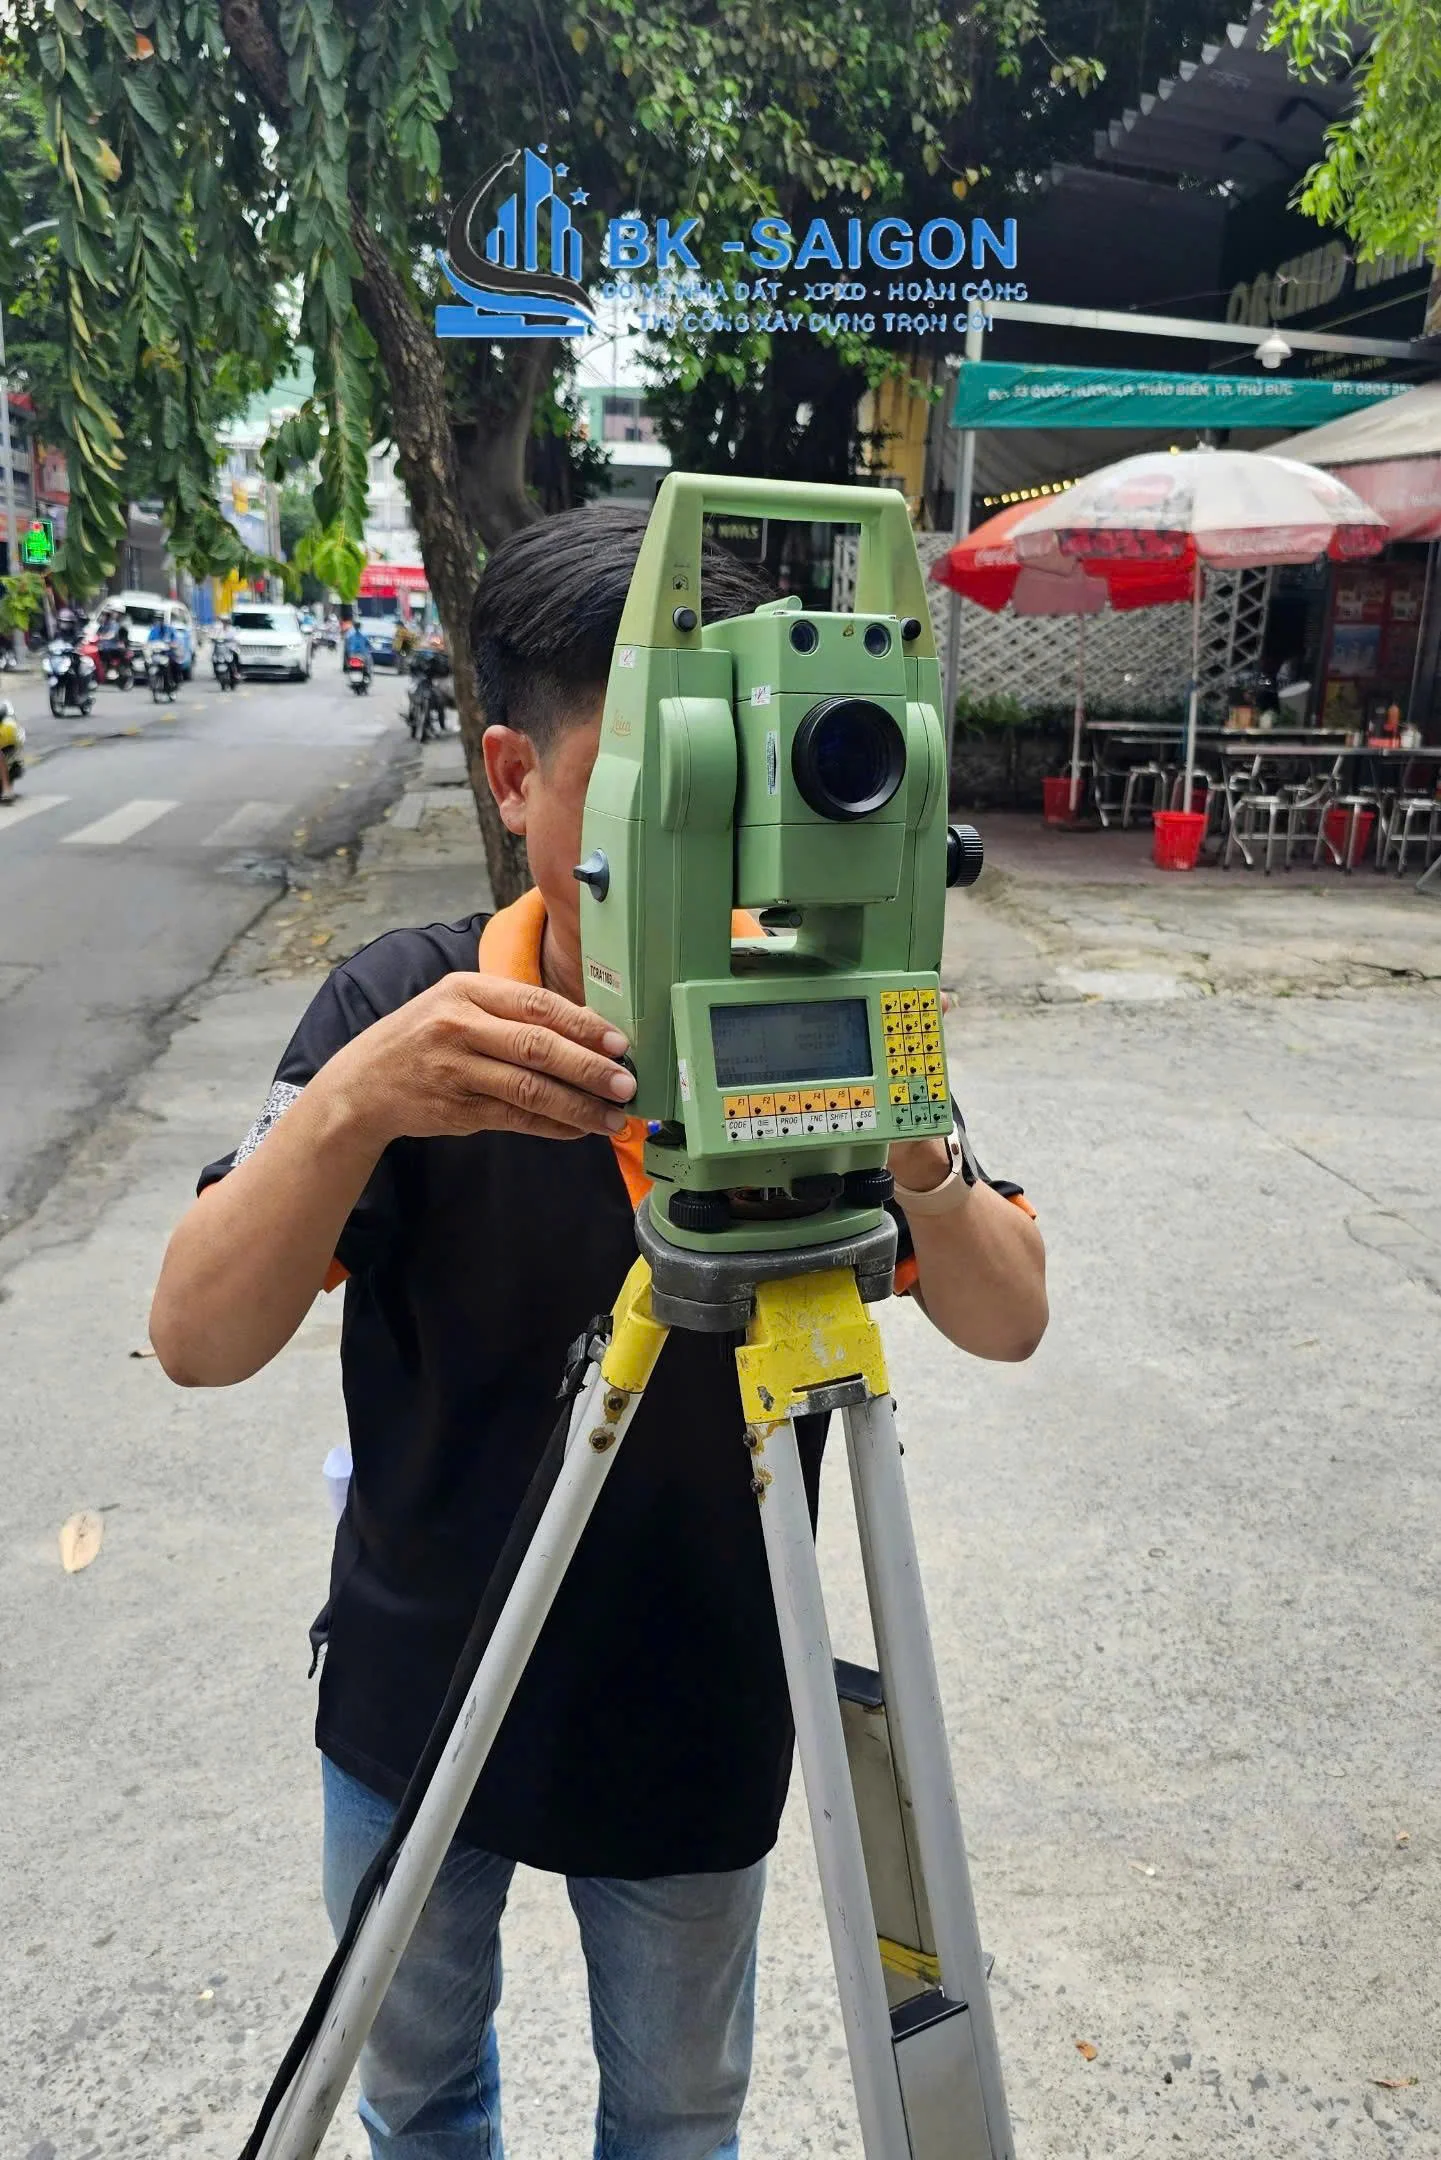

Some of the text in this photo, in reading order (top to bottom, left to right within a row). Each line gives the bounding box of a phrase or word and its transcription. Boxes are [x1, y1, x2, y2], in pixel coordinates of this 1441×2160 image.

[813, 1092, 821, 1100] F4
[862, 1088, 870, 1096] F6
[738, 1098, 745, 1106] F1
[788, 1094, 796, 1102] F3
[810, 1114, 824, 1122] FNC
[829, 1112, 849, 1121] SHIFT
[860, 1110, 873, 1118] ESC
[780, 1116, 798, 1124] PROG
[729, 1121, 747, 1129] CODE
